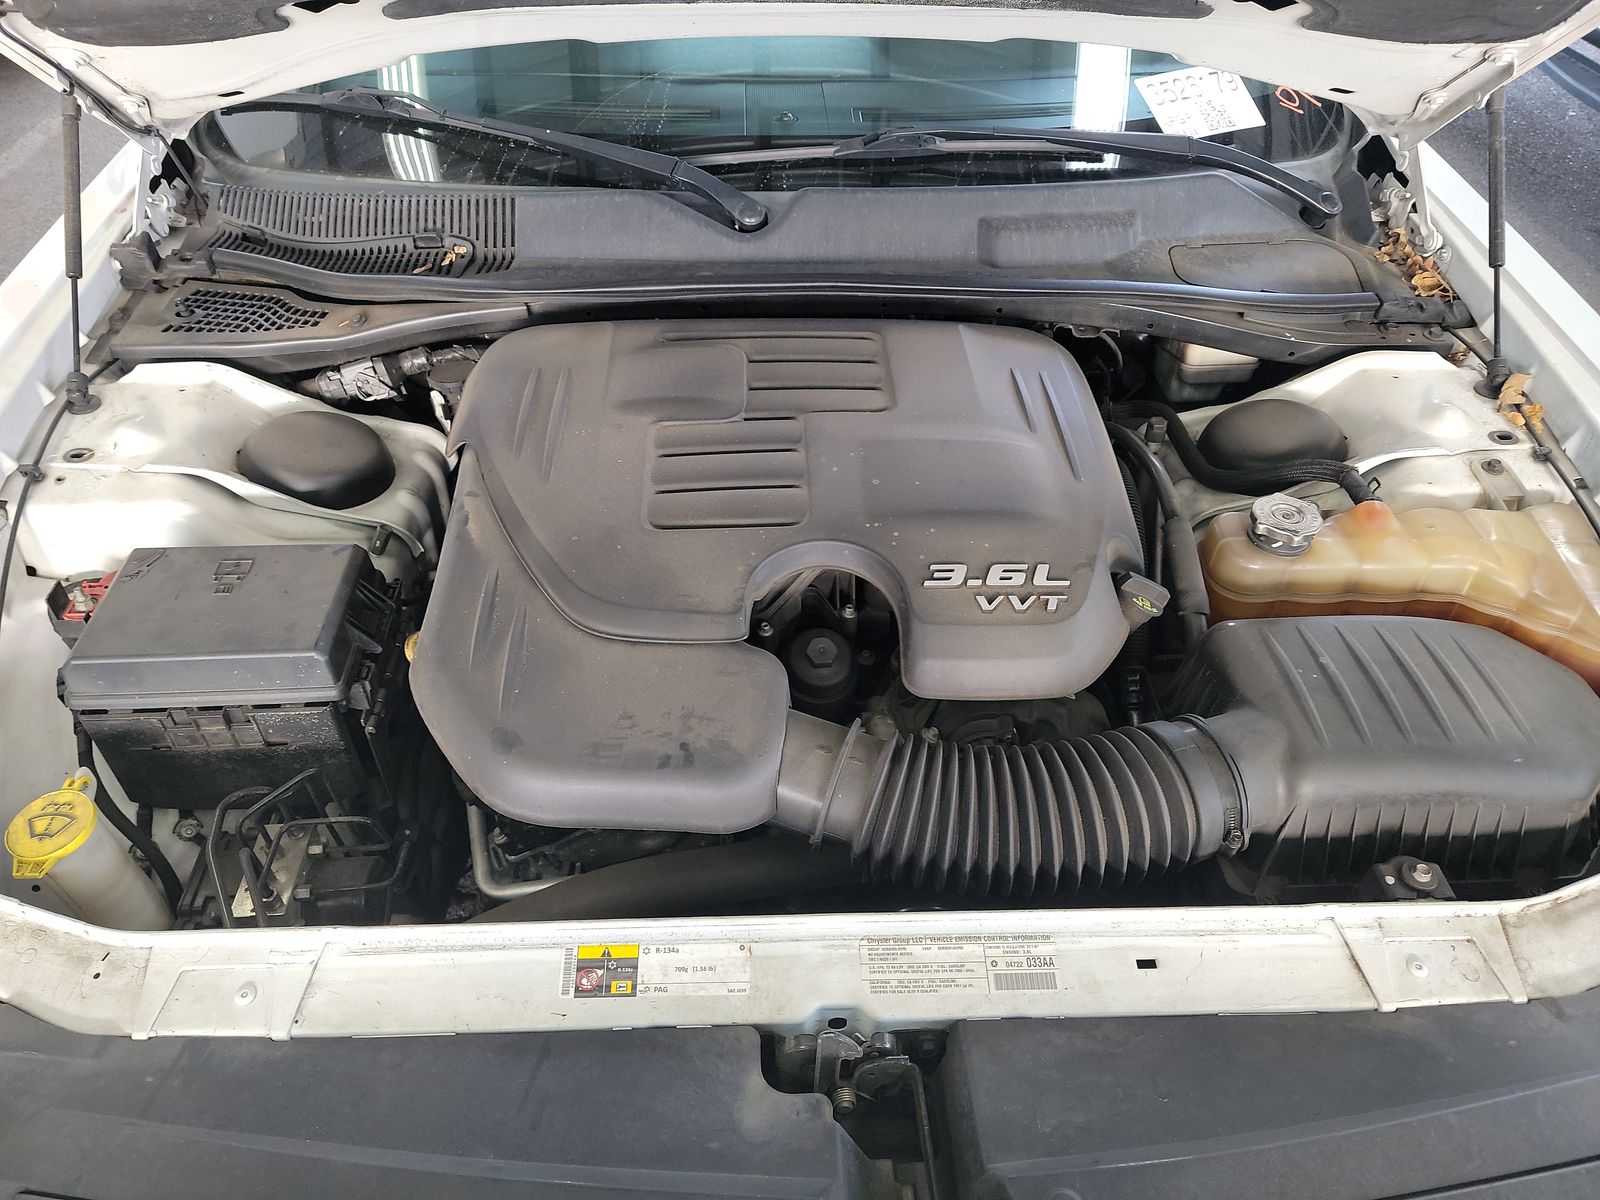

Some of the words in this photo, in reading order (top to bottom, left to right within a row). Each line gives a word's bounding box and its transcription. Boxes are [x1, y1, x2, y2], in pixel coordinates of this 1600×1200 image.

[922, 563, 1071, 588] 3.6L
[975, 595, 1068, 612] VVT
[867, 937, 890, 945] Chrysler
[892, 937, 910, 945] Group
[1026, 957, 1055, 968] 033AA
